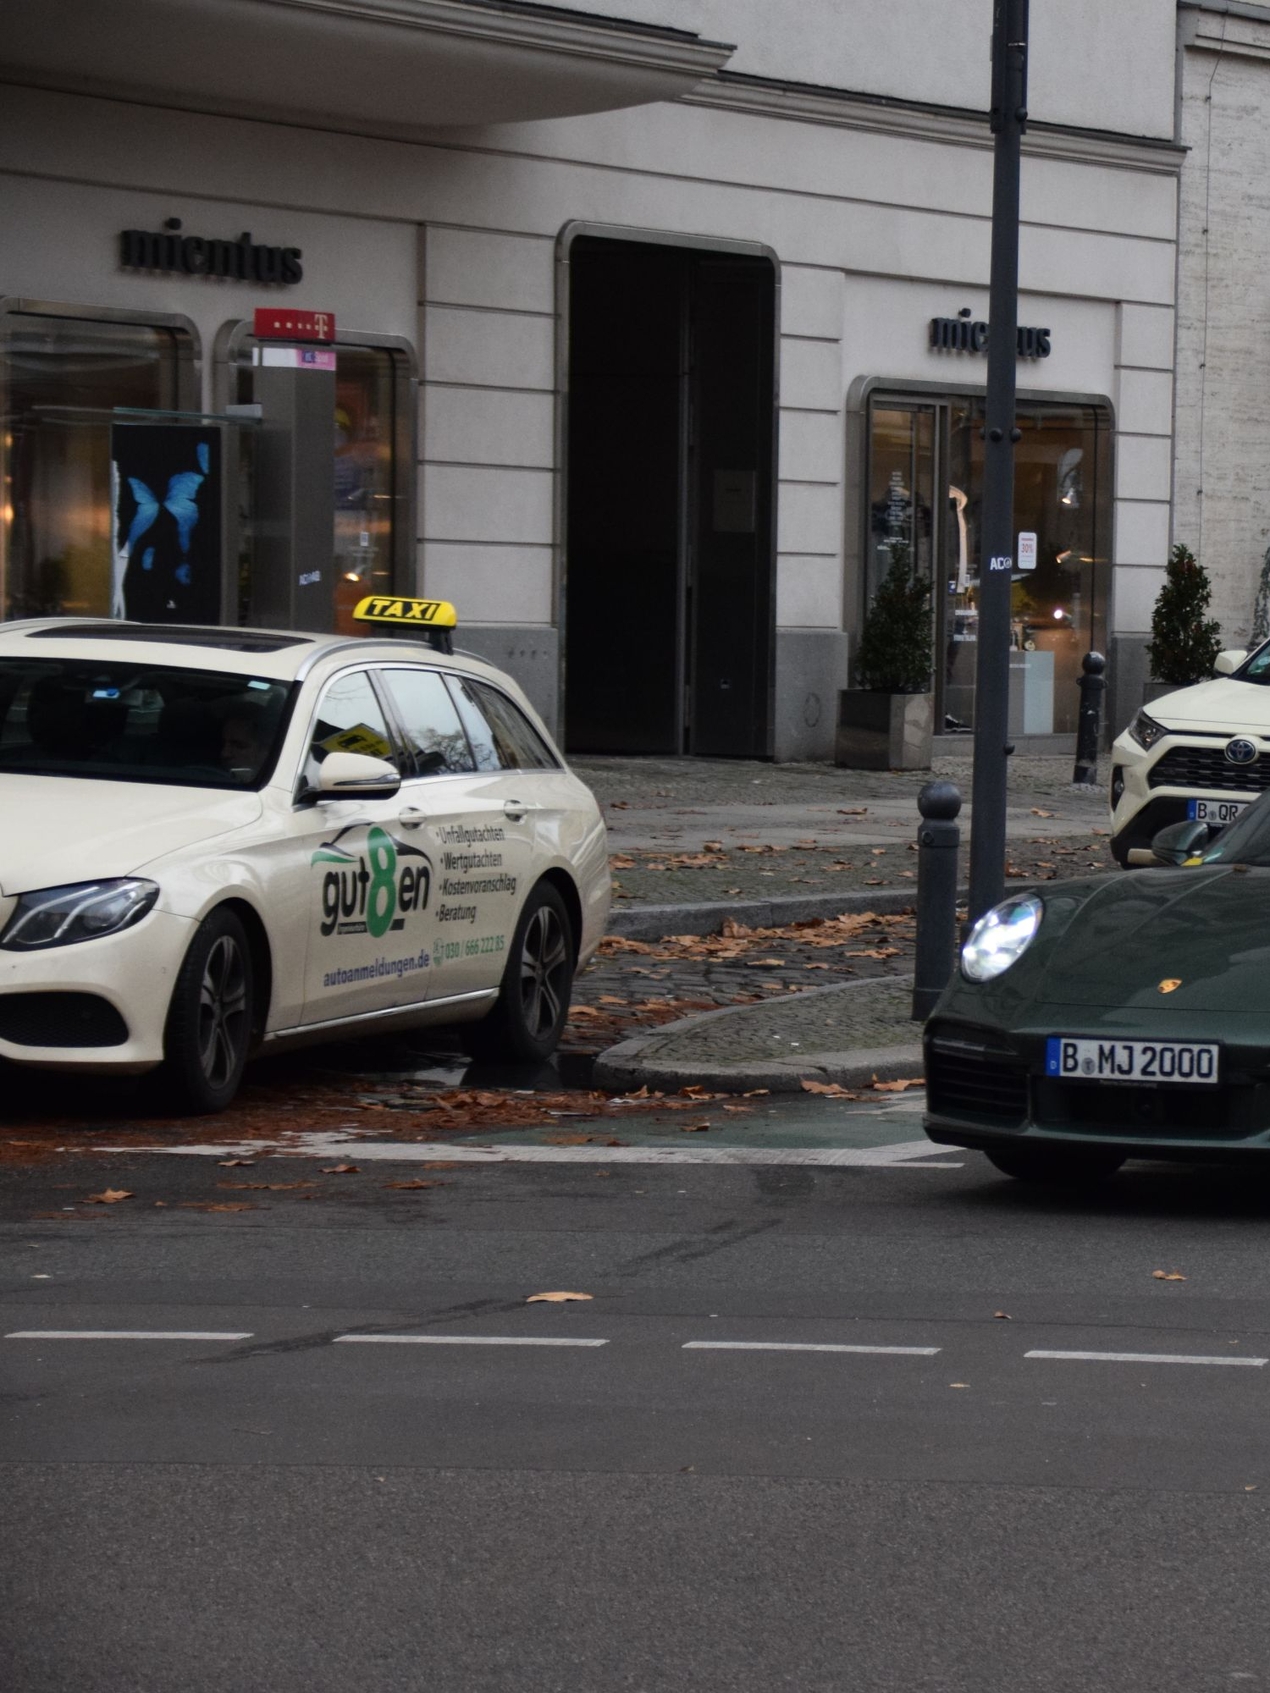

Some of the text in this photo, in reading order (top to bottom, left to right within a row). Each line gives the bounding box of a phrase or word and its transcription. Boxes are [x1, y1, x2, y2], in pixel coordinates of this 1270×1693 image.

[120, 217, 303, 284] mientus
[929, 307, 1051, 358] mieus
[371, 600, 438, 620] TAXI
[1197, 802, 1239, 821] B QR
[440, 825, 505, 847] Unfallgutachten
[443, 849, 503, 873] Wertgutachten
[320, 826, 431, 938] gut8en
[442, 873, 517, 896] Kostenvoranschlag
[438, 903, 477, 924] Beratung
[323, 949, 430, 987] autoanmeldungen.de
[1062, 1042, 1079, 1073] B
[1098, 1044, 1134, 1076] MJ
[1141, 1046, 1214, 1079] 2000
